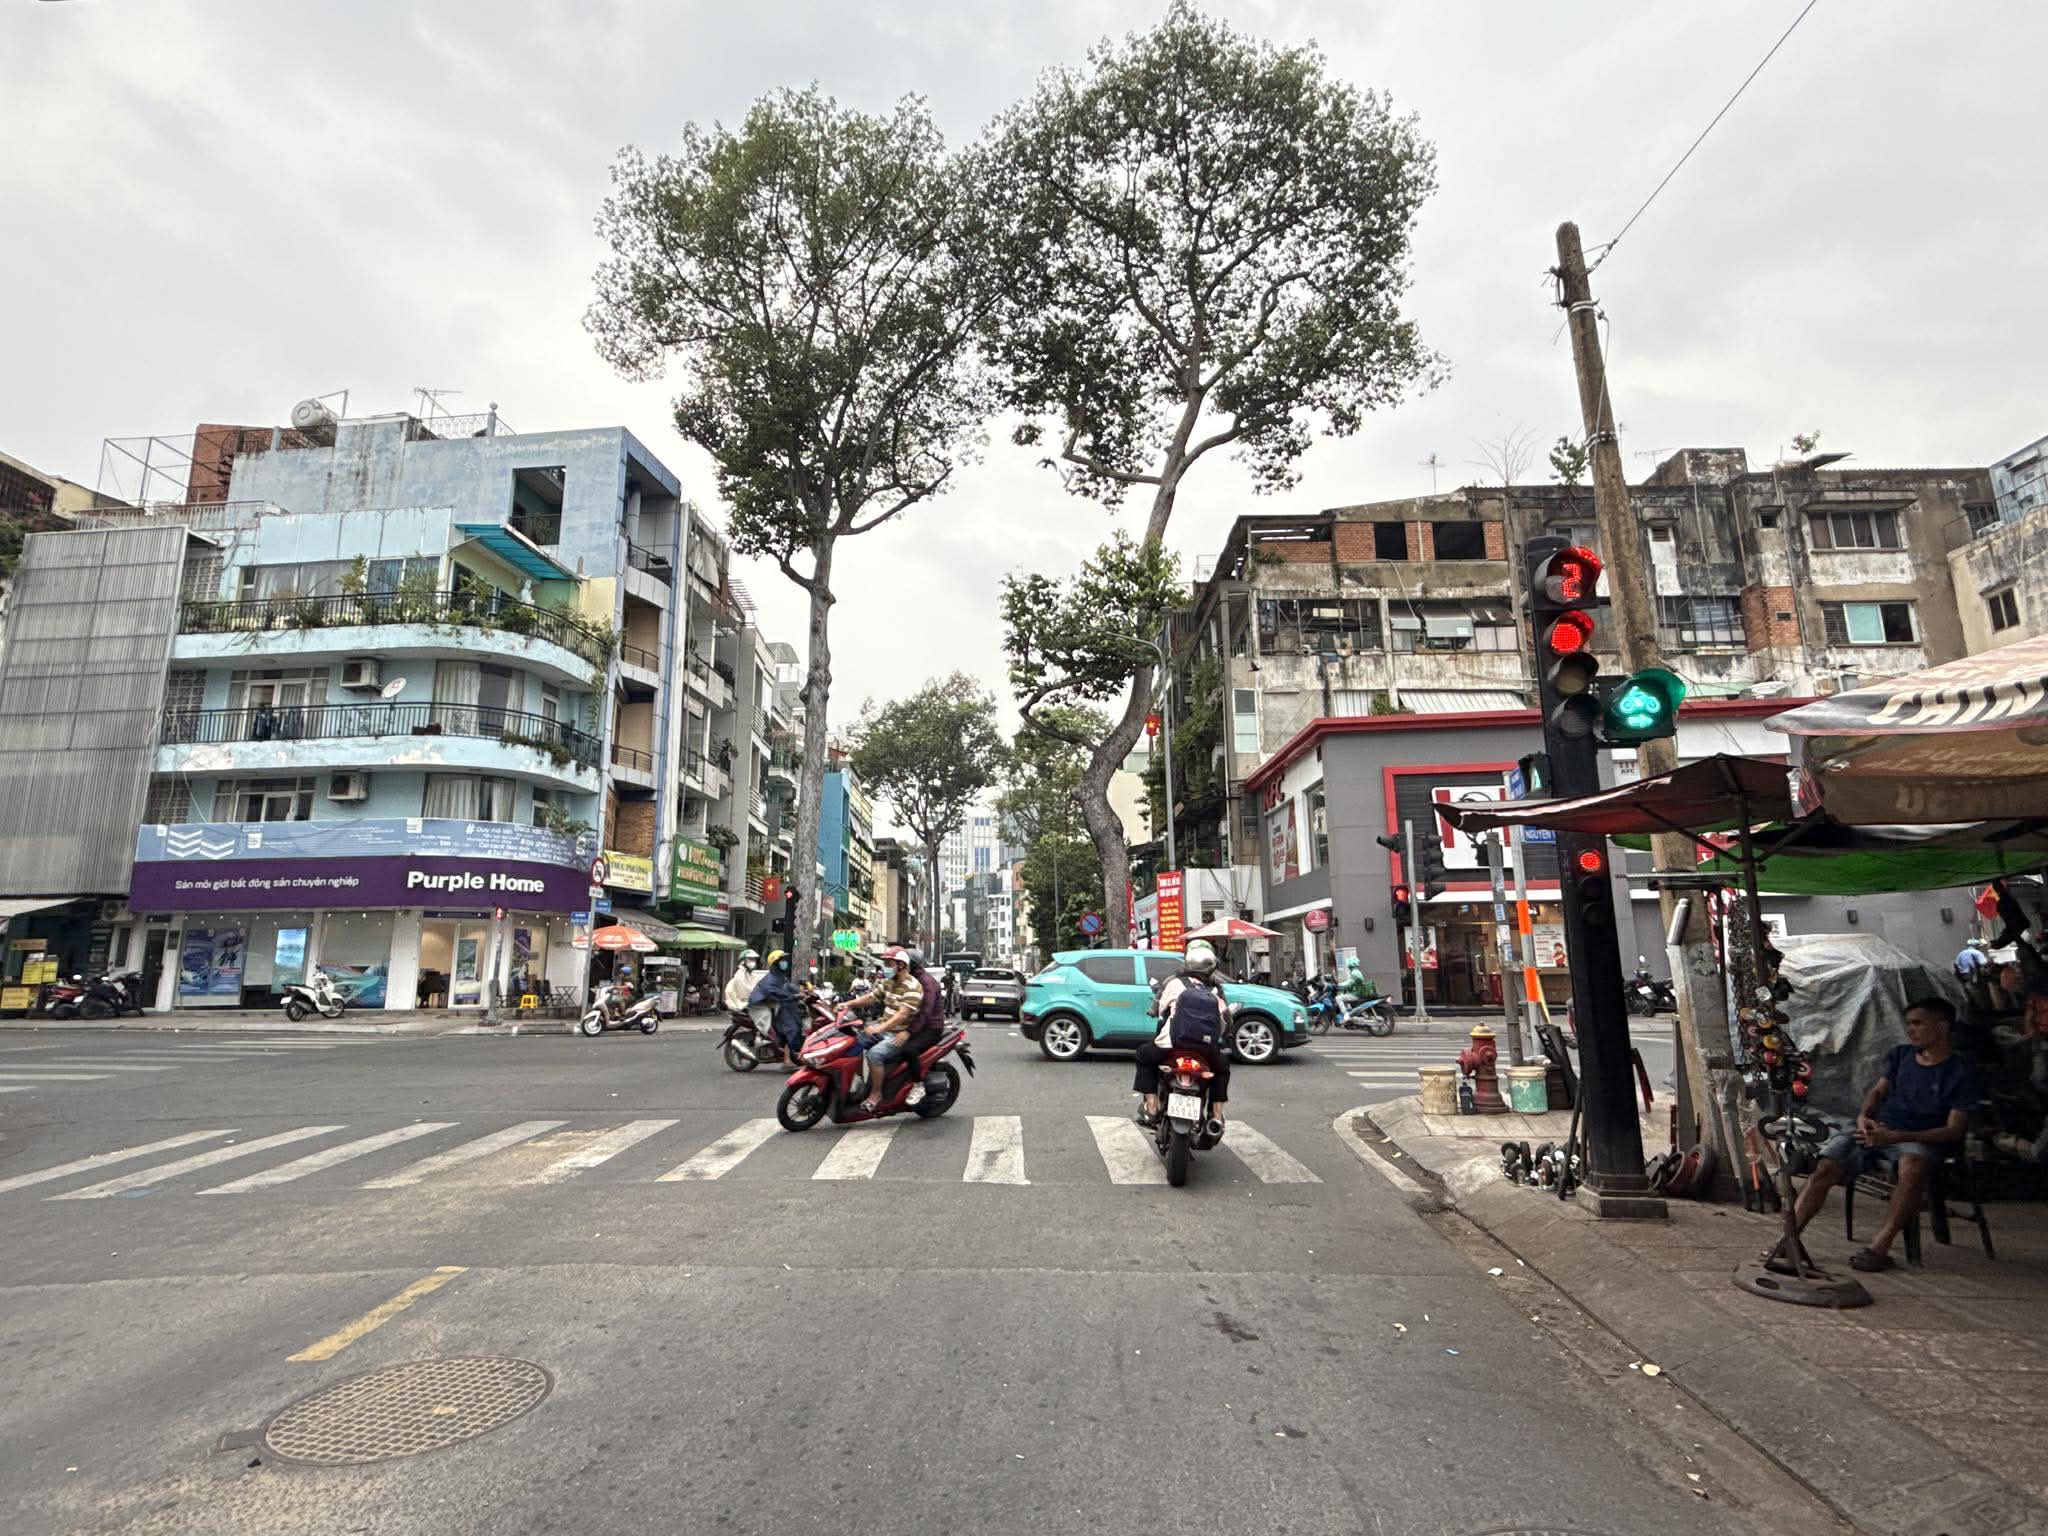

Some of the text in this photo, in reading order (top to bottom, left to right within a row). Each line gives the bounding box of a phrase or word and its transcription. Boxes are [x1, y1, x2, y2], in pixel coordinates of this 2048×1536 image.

[292, 876, 326, 889] chuyên
[328, 876, 360, 888] nghiệp
[407, 871, 545, 893] Purple Home
